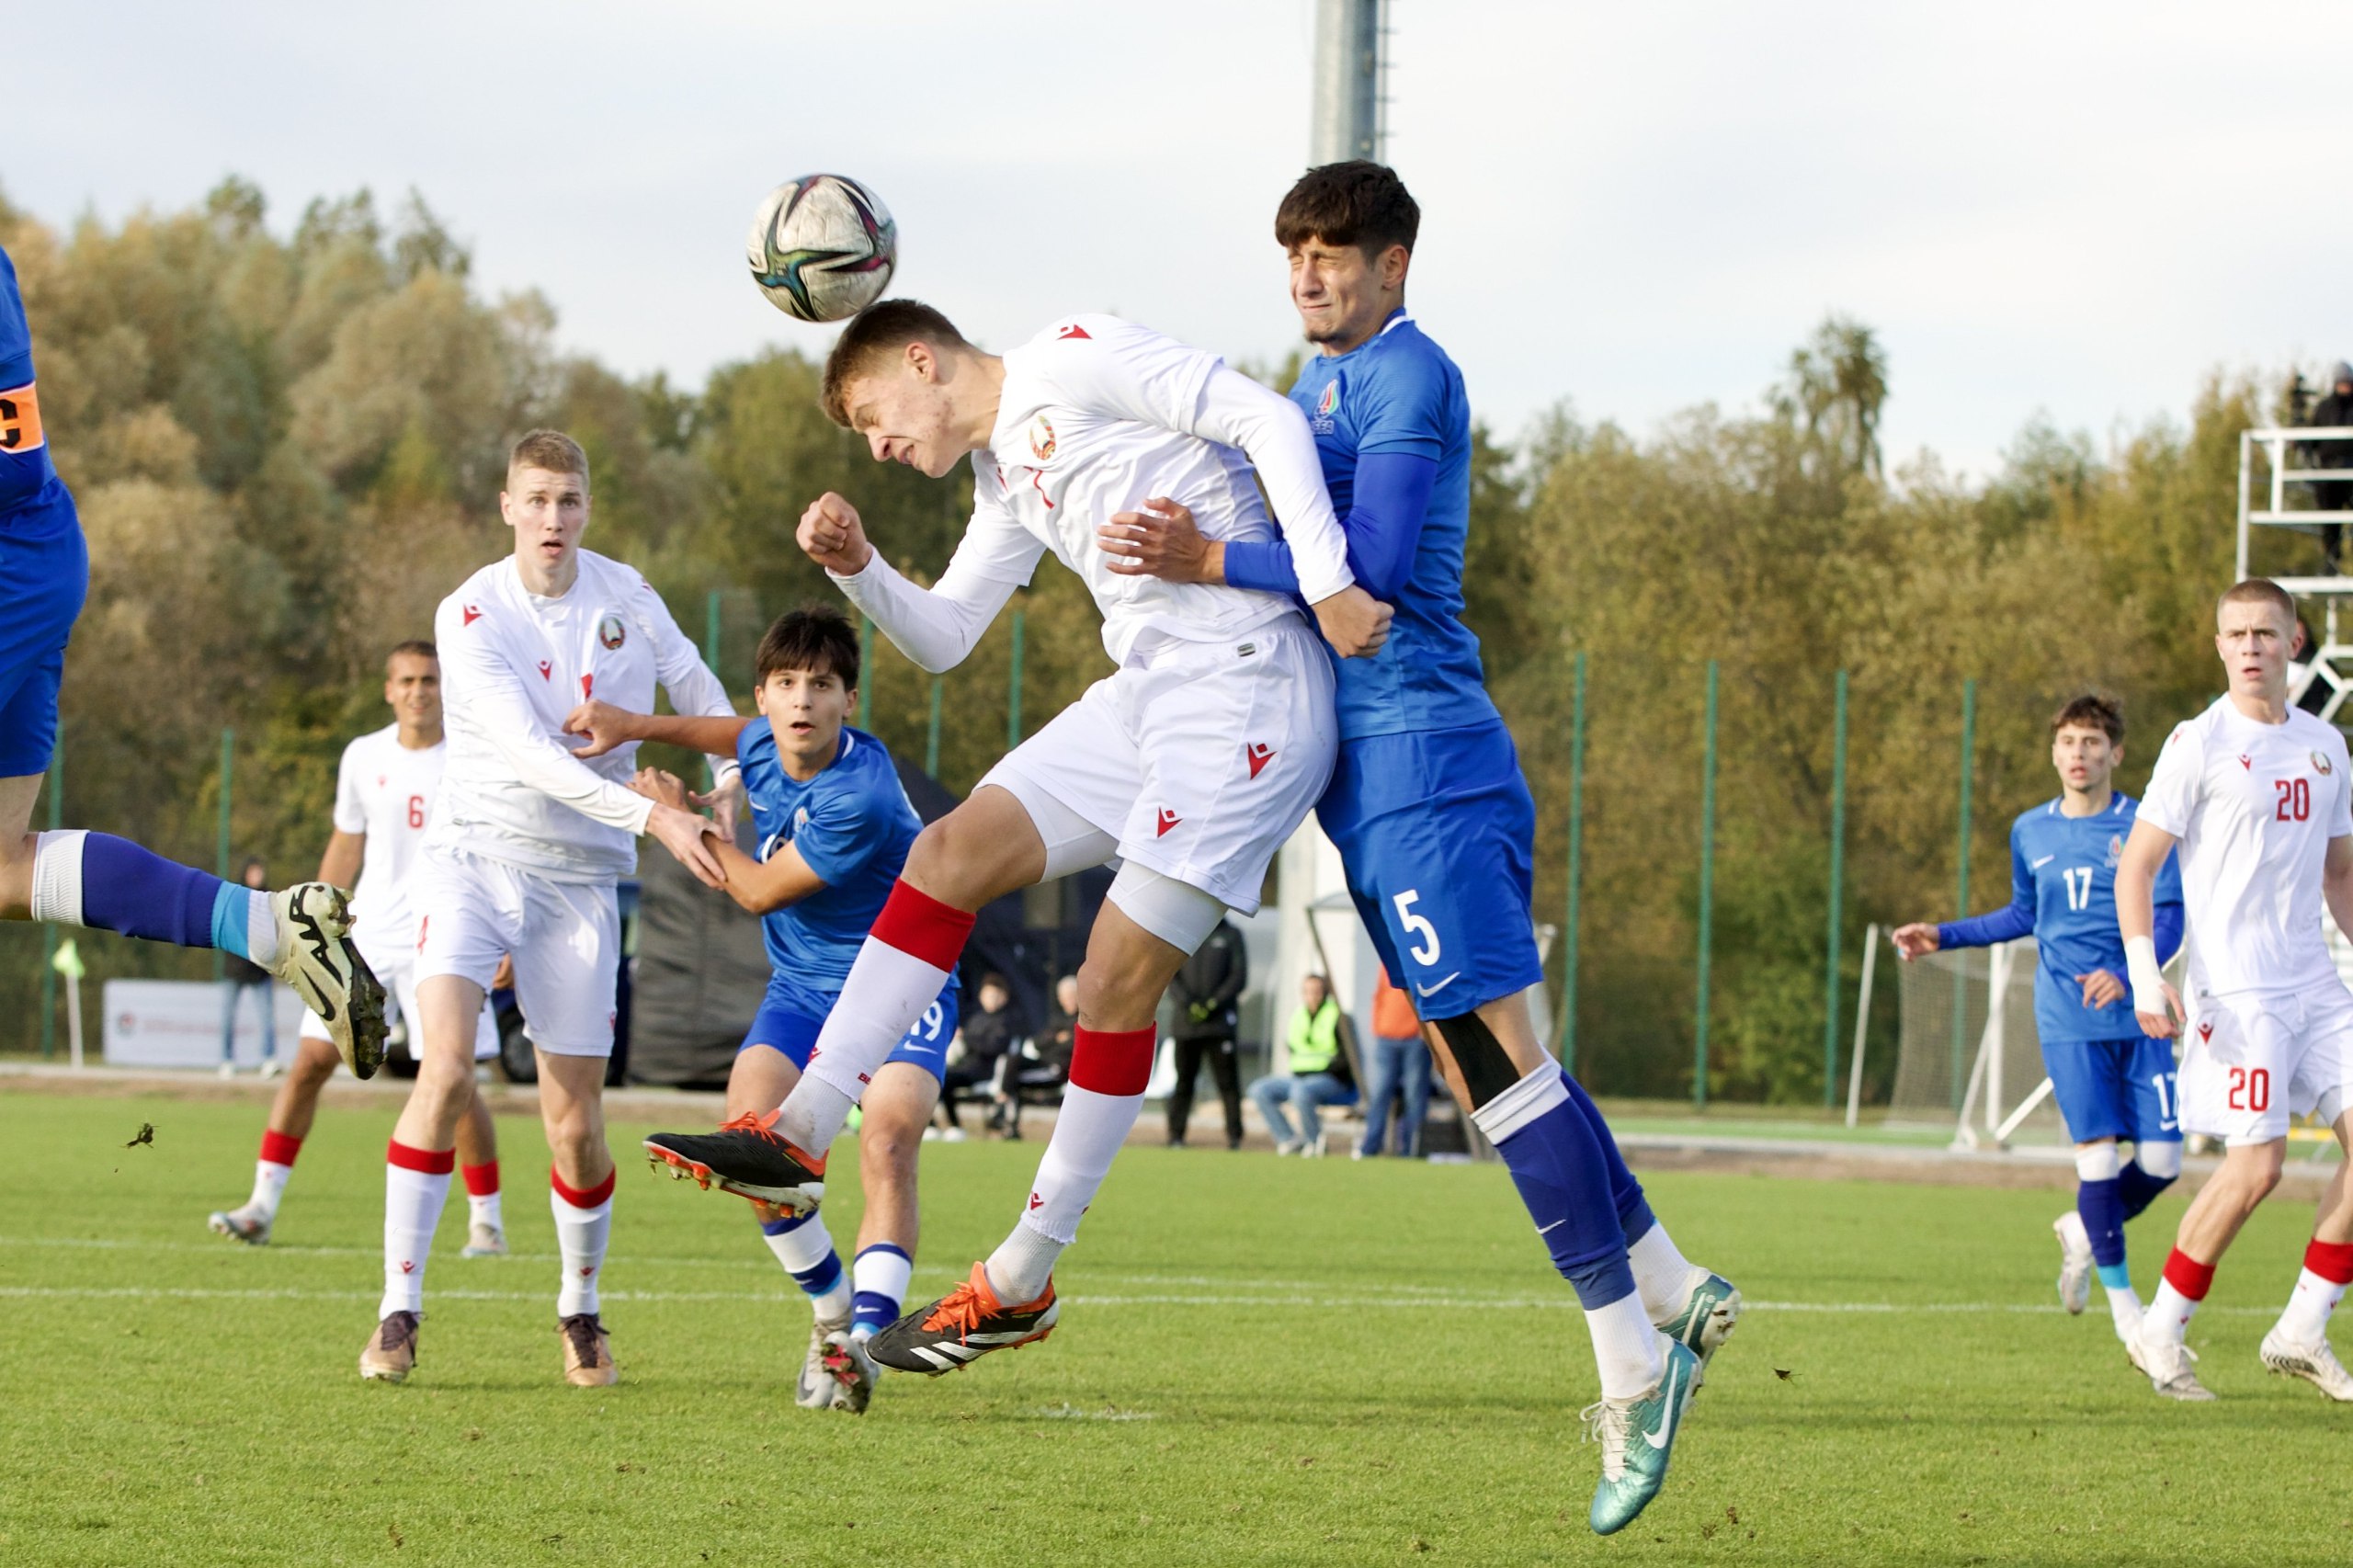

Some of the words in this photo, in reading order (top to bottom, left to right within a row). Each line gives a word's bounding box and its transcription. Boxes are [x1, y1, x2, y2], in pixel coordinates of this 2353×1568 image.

[408, 795, 424, 828] 6
[2274, 778, 2310, 822] 20
[2062, 866, 2093, 910] 17
[1392, 889, 1441, 966] 5
[2228, 1067, 2269, 1112] 20
